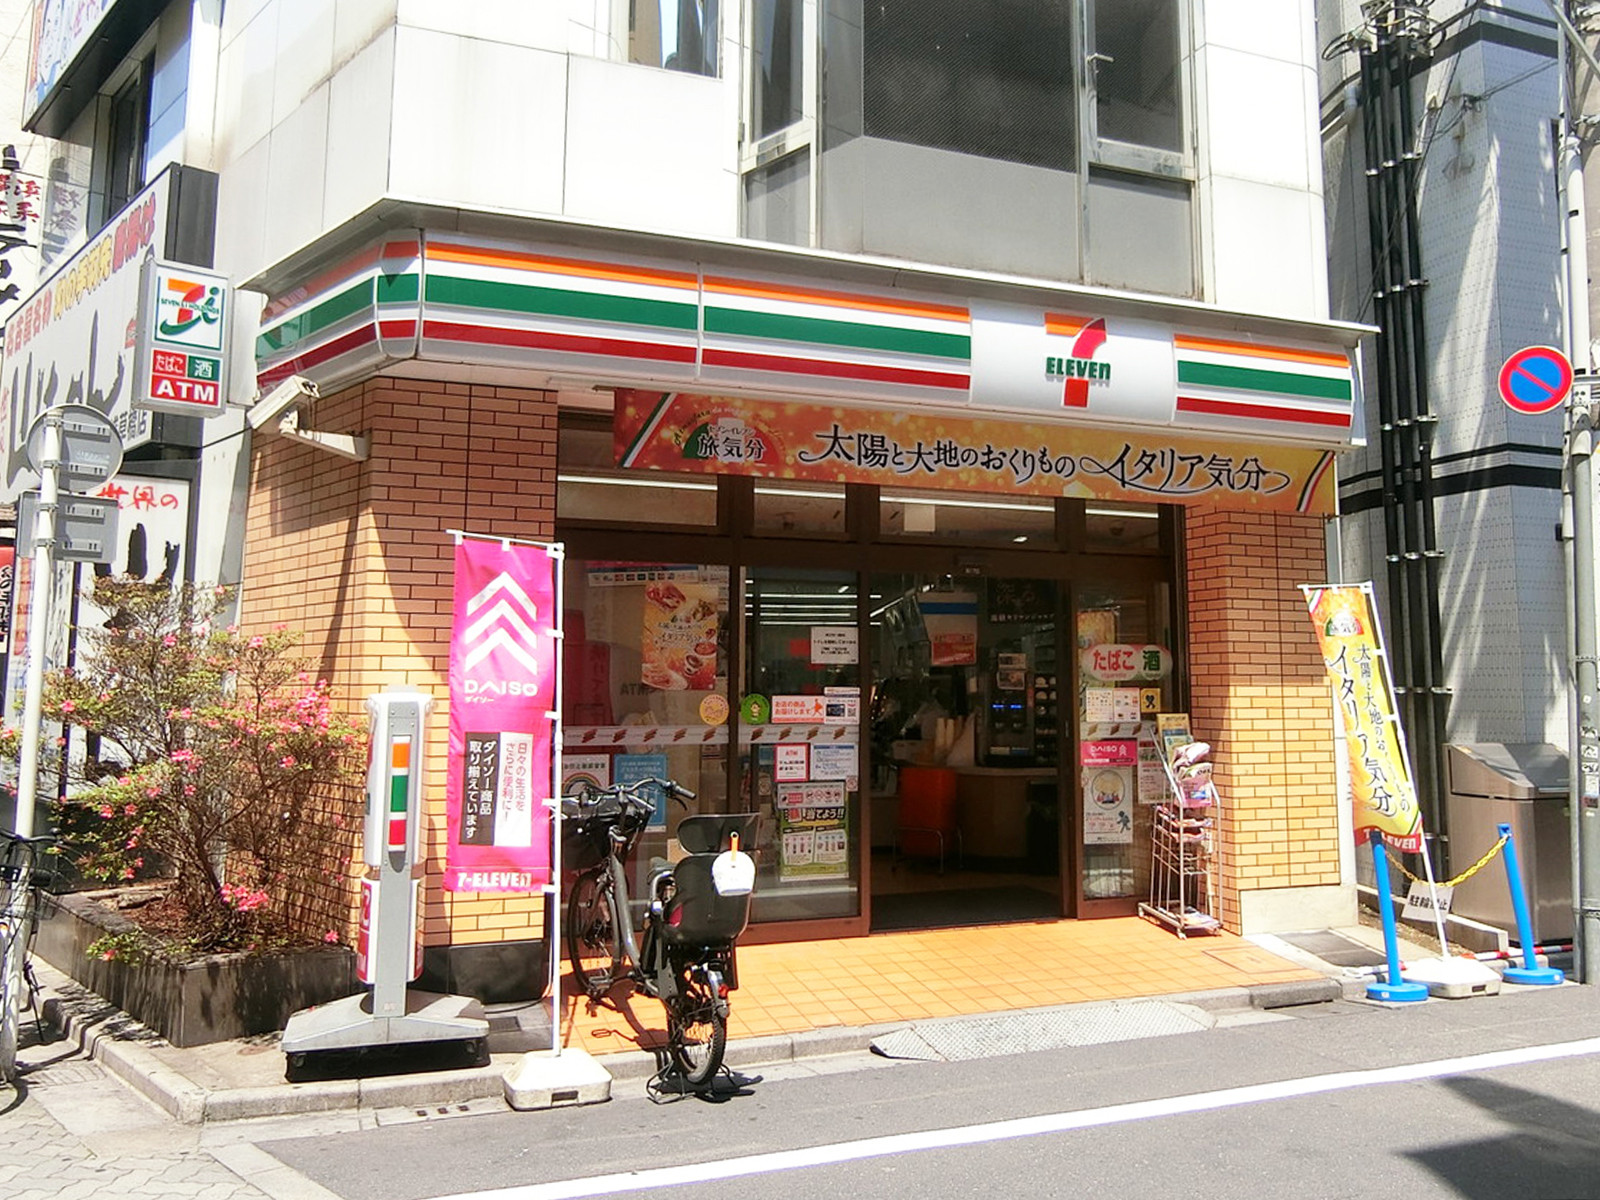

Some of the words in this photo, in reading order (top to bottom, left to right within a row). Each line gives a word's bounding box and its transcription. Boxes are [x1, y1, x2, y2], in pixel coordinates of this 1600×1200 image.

[155, 355, 184, 374] たばこ
[194, 360, 213, 378] 酒
[157, 379, 215, 402] ATM
[698, 435, 766, 460] 旅気分
[799, 423, 1075, 483] 太陽と大地のおくりもの
[1079, 441, 1292, 495] イタリア気分
[1093, 649, 1136, 671] たばこ
[1142, 650, 1160, 671] 酒
[464, 680, 538, 696] DAISO
[1325, 645, 1397, 817] イタリア気分
[465, 741, 482, 839] 取り揃えています
[479, 740, 498, 816] ダイソー商品
